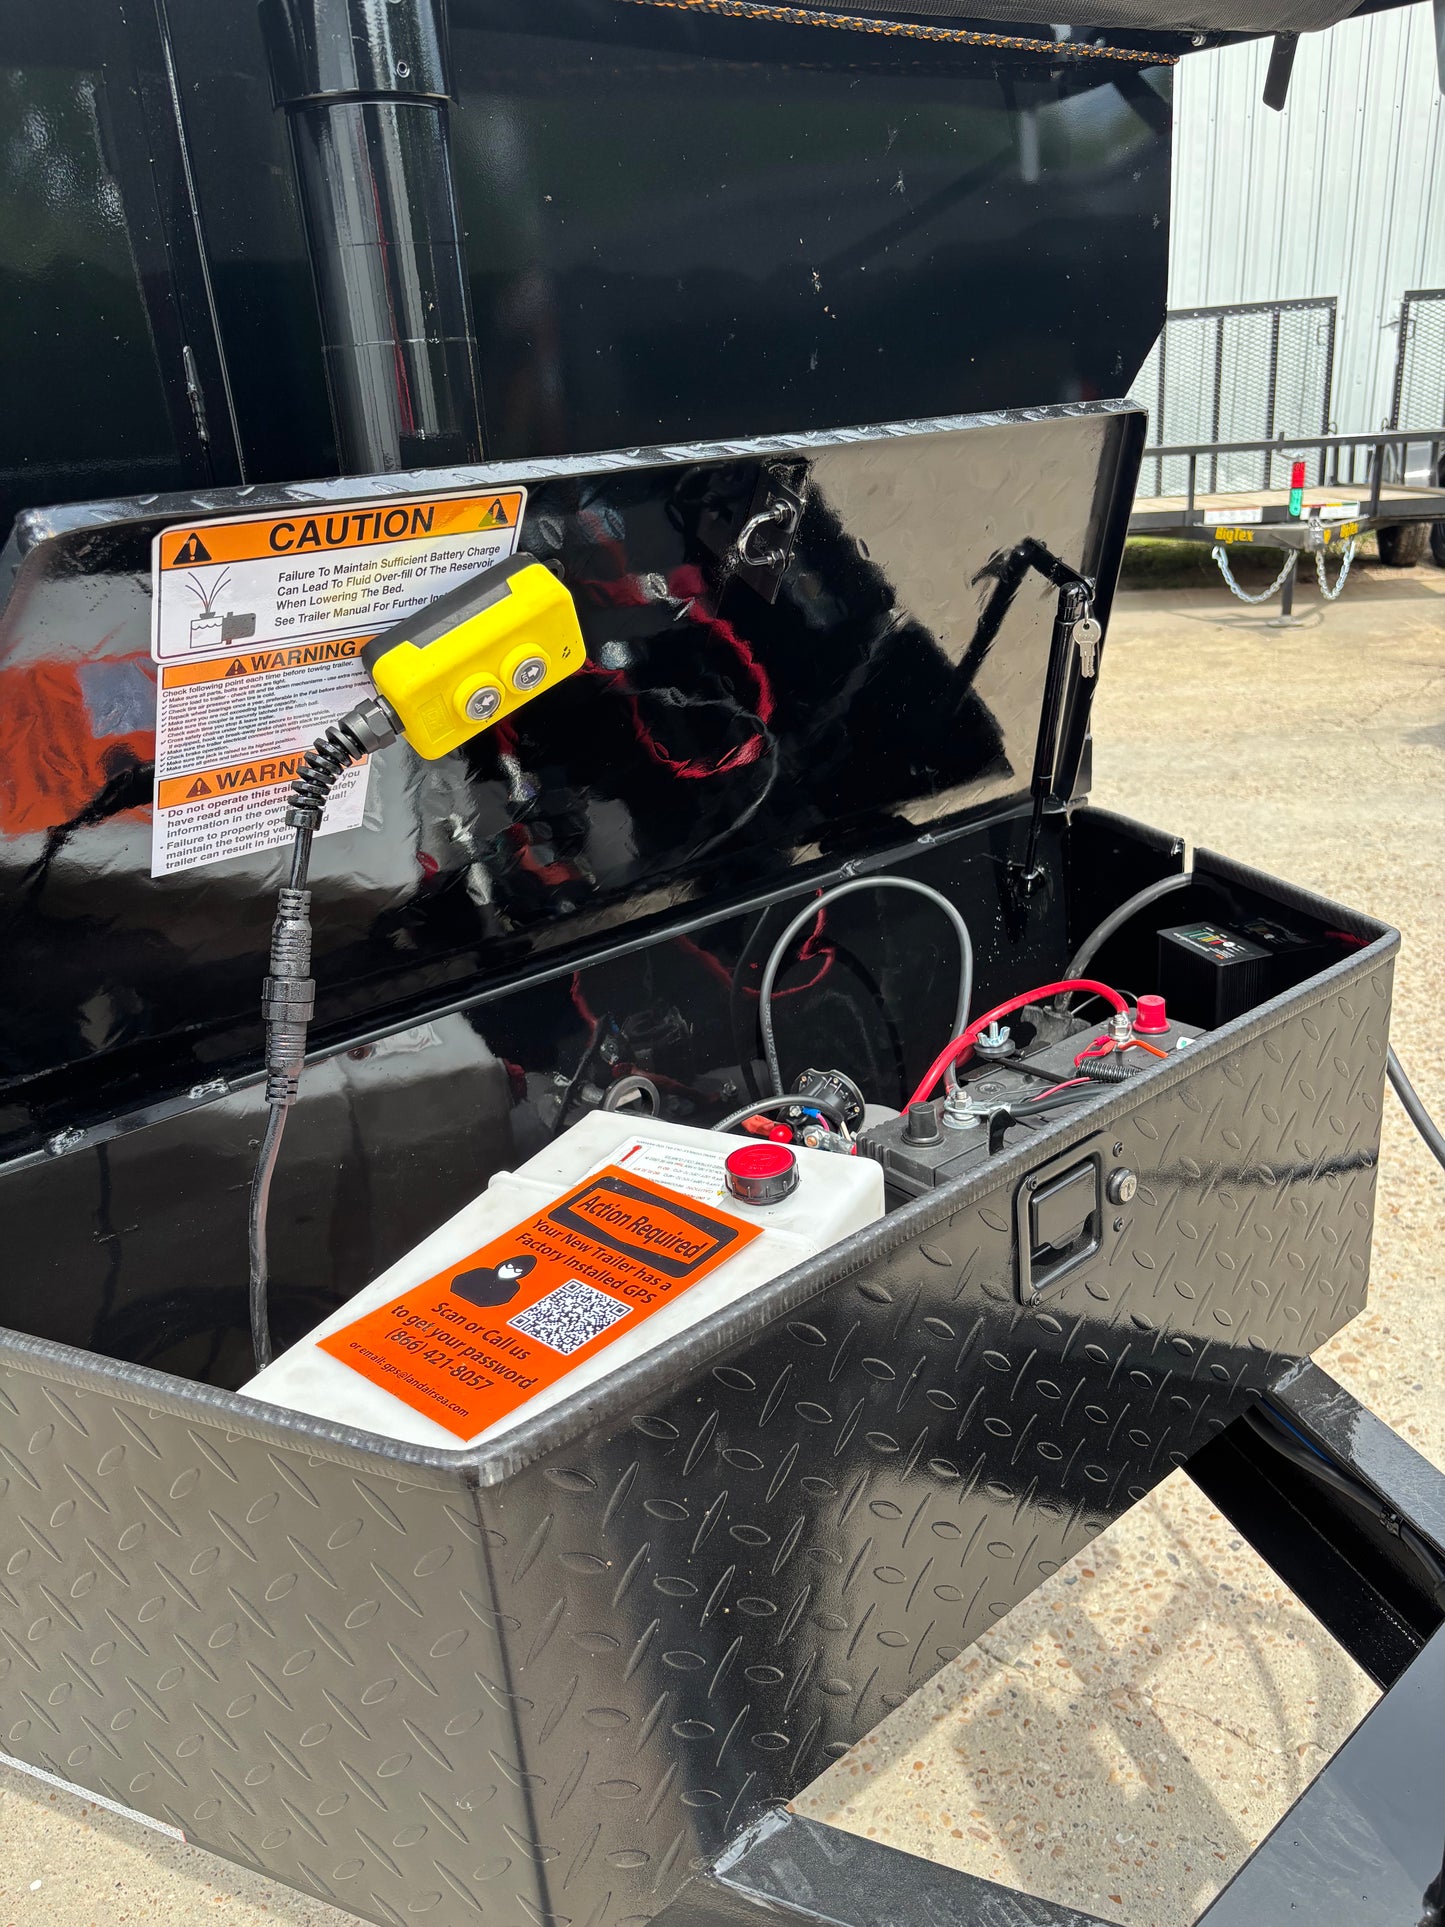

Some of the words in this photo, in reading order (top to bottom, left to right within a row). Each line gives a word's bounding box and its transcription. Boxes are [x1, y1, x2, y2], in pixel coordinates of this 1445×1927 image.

[269, 507, 435, 551] CAUTION
[277, 586, 298, 596] Can
[302, 580, 328, 592] Lead
[331, 578, 343, 588] To
[346, 574, 371, 586] Fluid
[374, 569, 412, 582] Over-fill
[415, 566, 427, 576] Of
[429, 565, 446, 574] The
[449, 558, 495, 571] Reservoir
[278, 570, 314, 582] Failure
[318, 566, 330, 576] To
[333, 561, 377, 574] Maintain
[381, 554, 427, 568] Sufficient
[430, 550, 464, 561] Battery
[467, 546, 500, 556] Charge
[274, 616, 294, 626] See
[298, 611, 330, 622] Trailer
[333, 604, 370, 617] Manual
[373, 602, 390, 611] For
[392, 597, 427, 608] Further
[276, 599, 306, 609] When
[309, 592, 357, 605] Lowering
[361, 588, 379, 597] The
[382, 583, 403, 594] Bed.
[251, 641, 356, 670] WARNING
[162, 688, 186, 697] Check
[189, 683, 223, 692] following
[224, 678, 243, 687] point
[168, 809, 183, 817] Do
[186, 803, 204, 813] not
[207, 795, 248, 808] operate
[251, 789, 270, 799] this
[274, 786, 292, 794] trai
[342, 771, 360, 780] you
[167, 817, 193, 827] have
[197, 809, 220, 820] read
[223, 804, 243, 815] and
[167, 819, 228, 837] information
[245, 811, 262, 819] the
[264, 804, 294, 815] owne
[166, 836, 204, 849] Failure
[220, 821, 264, 838] properly
[166, 843, 212, 859] maintain
[215, 838, 232, 847] the
[235, 830, 269, 842] towing
[166, 856, 197, 868] trailer
[200, 851, 219, 860] can
[222, 842, 251, 854] result
[579, 1196, 630, 1225] Action
[627, 1216, 705, 1263] Required
[516, 1233, 565, 1261] Factory
[564, 1256, 626, 1288] Installed
[623, 1285, 656, 1303] GPS
[532, 1219, 562, 1237] Your
[560, 1233, 592, 1252] New
[591, 1247, 635, 1272] Trailer
[633, 1267, 660, 1285] has
[659, 1282, 671, 1291] a
[391, 1305, 409, 1317] to
[402, 1316, 434, 1331] get
[425, 1328, 465, 1348] your
[458, 1347, 536, 1388] password
[431, 1302, 466, 1324] Scan
[464, 1322, 484, 1333] or
[482, 1330, 515, 1349] Call
[508, 1346, 530, 1359] us
[385, 1328, 427, 1353] (866)
[424, 1350, 492, 1389] 421-8057
[359, 1348, 385, 1365] email:
[382, 1364, 467, 1416] gps@landairsea.com
